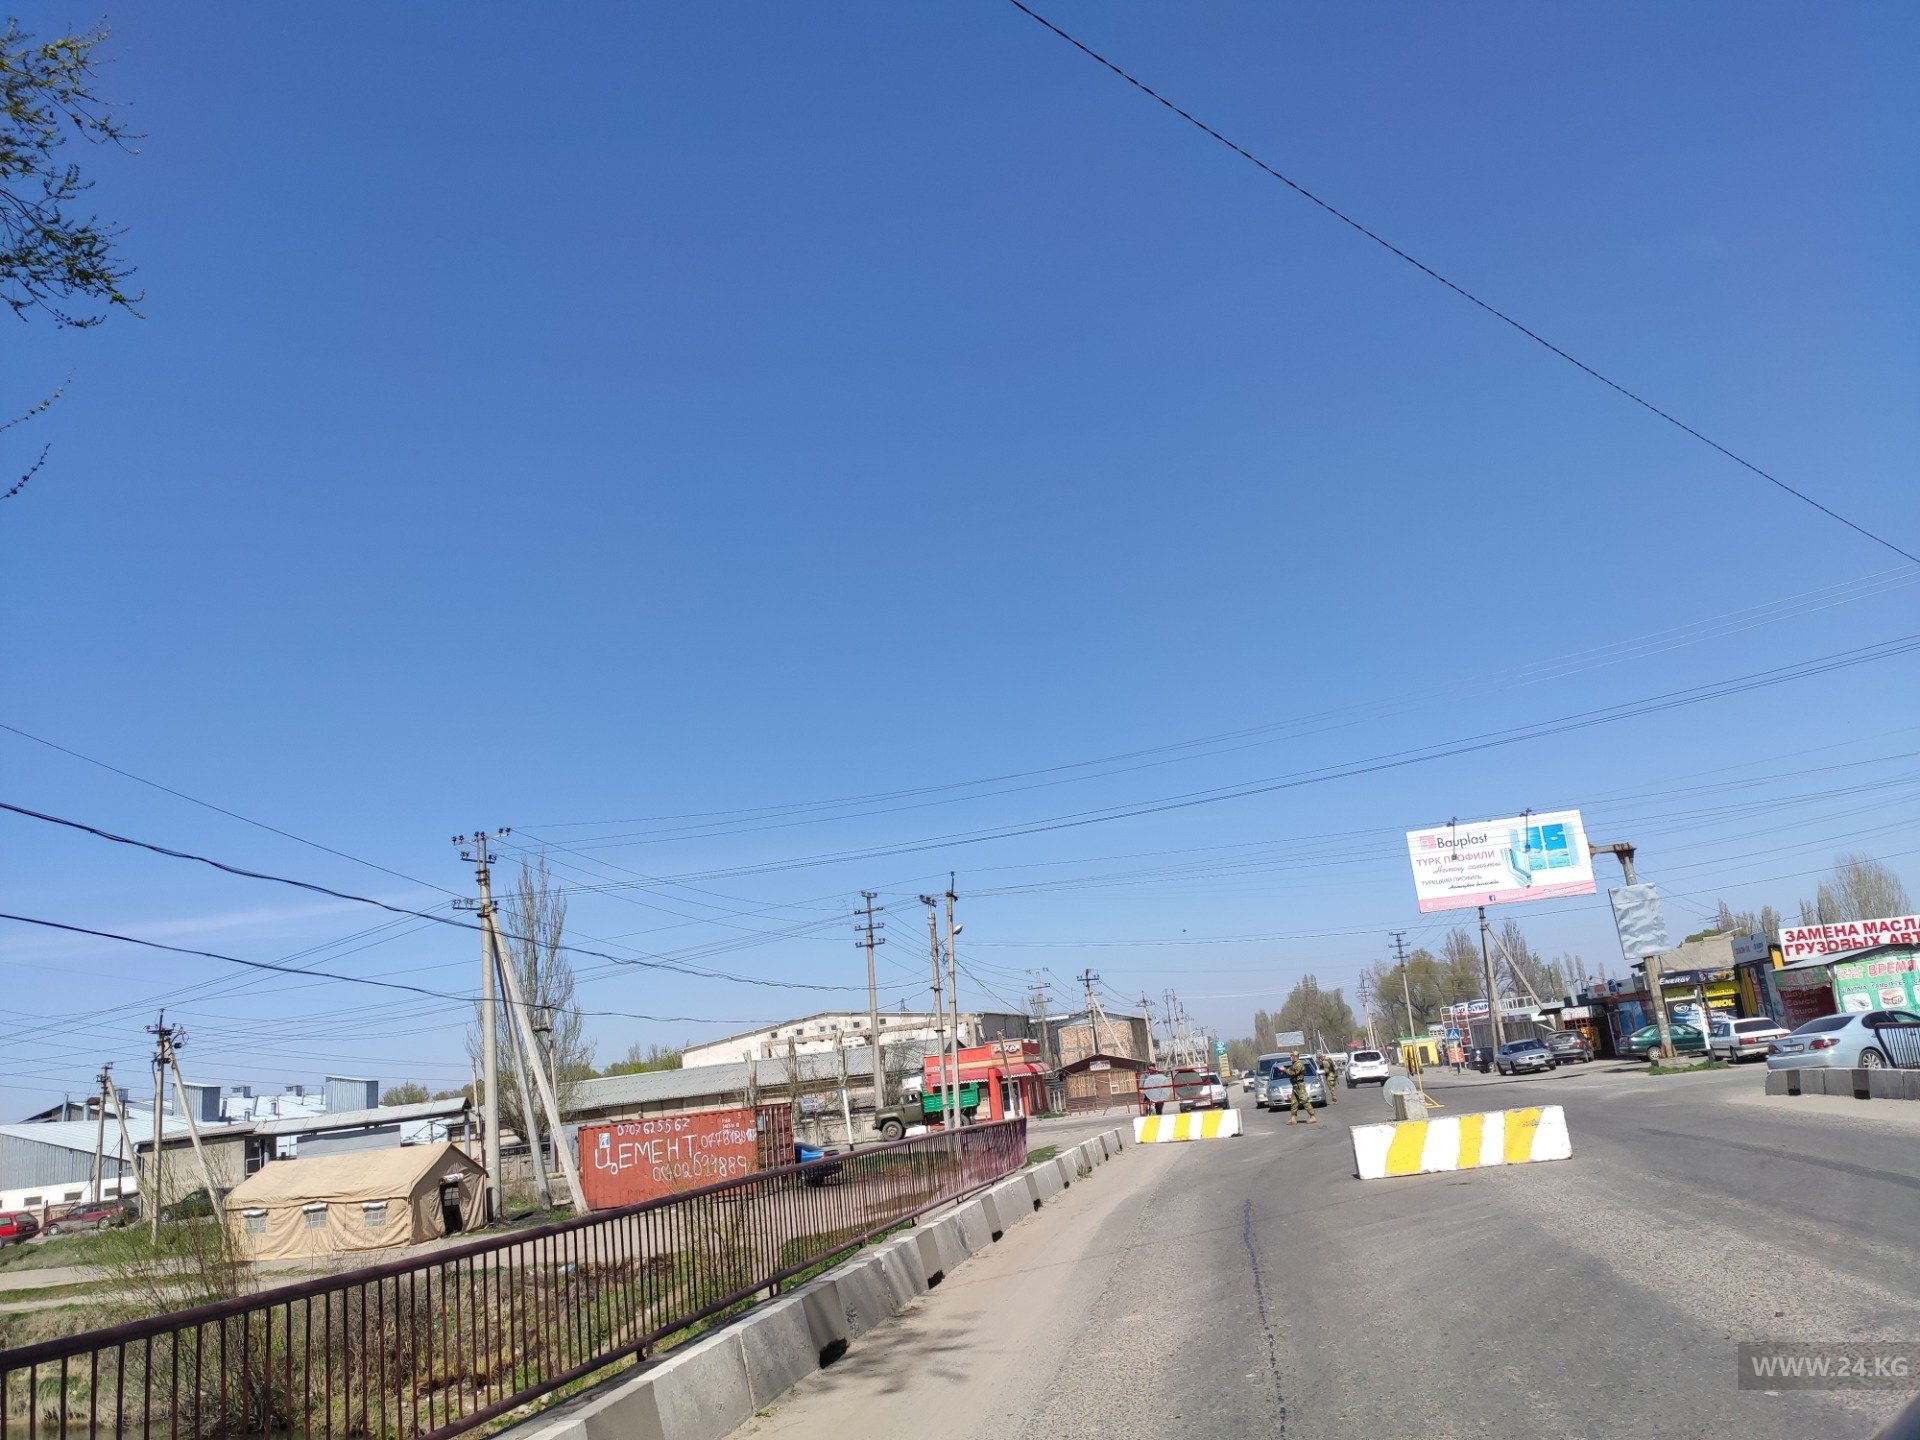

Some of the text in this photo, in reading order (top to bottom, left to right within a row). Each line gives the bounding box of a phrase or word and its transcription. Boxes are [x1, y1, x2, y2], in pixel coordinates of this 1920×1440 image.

[1437, 833, 1488, 849] Bauplast
[1784, 918, 1920, 943] ЗАМЕНА МАСЛ
[1784, 935, 1880, 957] ГРУЗОВЫХ
[1868, 960, 1917, 977] ВРЕМЯ
[594, 1134, 698, 1174] ЦЕМЕНТ
